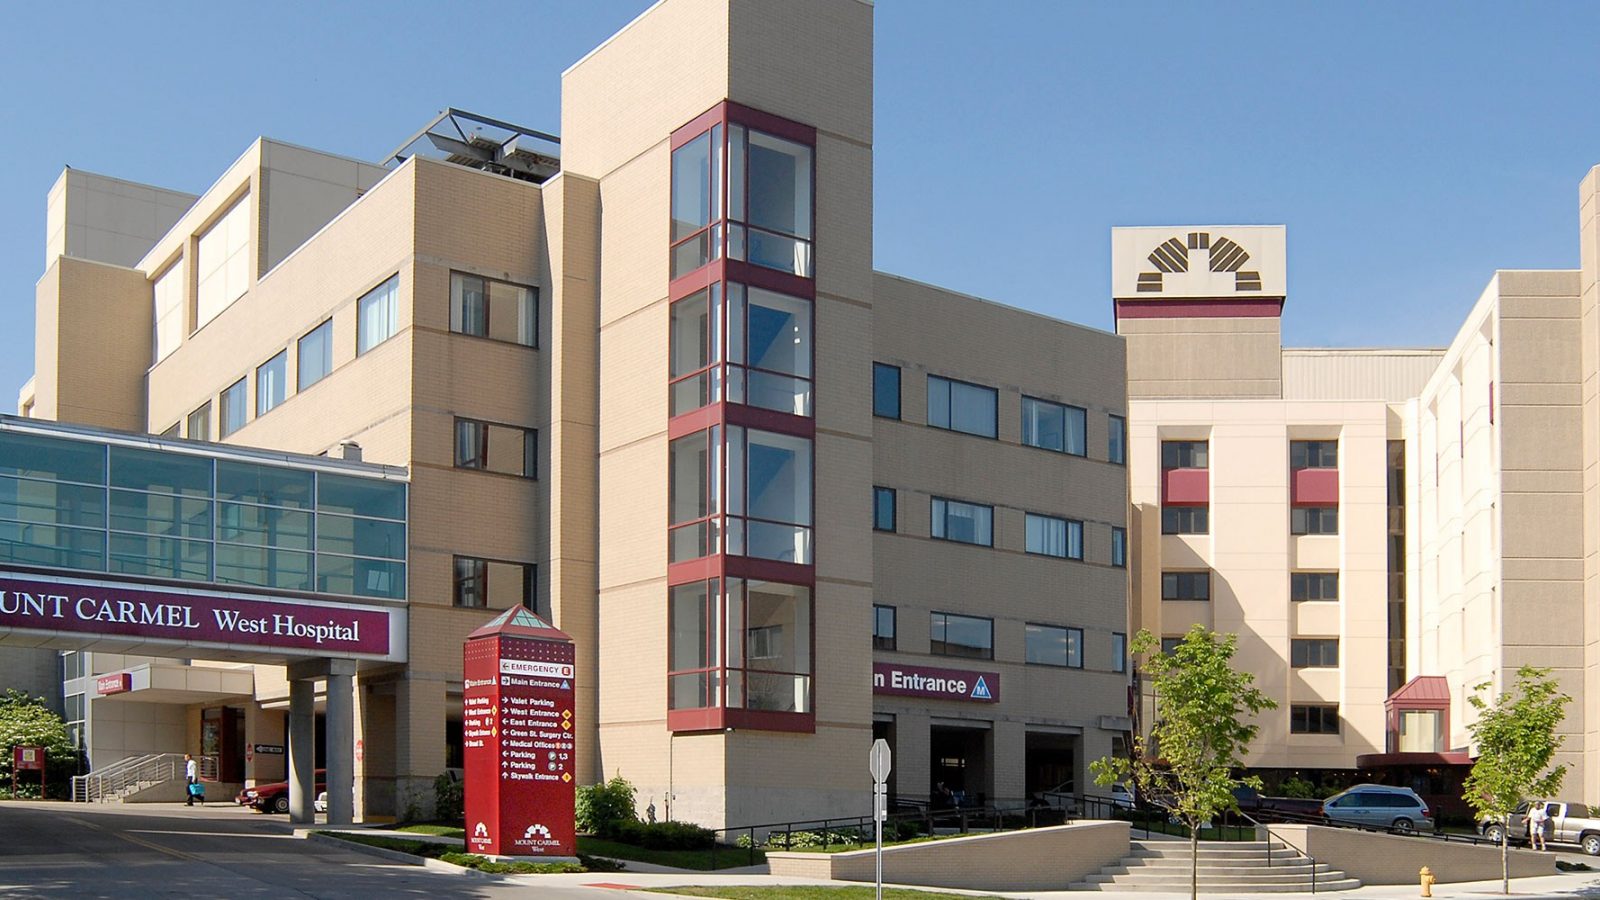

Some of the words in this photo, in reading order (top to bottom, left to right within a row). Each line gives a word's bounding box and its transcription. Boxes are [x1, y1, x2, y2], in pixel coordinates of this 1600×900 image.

[75, 597, 199, 628] CARMEL
[212, 609, 268, 634] West
[272, 614, 360, 643] Hospital
[511, 663, 559, 674] EMERGENCY
[511, 677, 528, 686] Main
[529, 679, 561, 689] Entrance
[891, 670, 967, 694] Entrance
[976, 685, 986, 696] M
[510, 697, 528, 705] Valet
[529, 698, 555, 708] Parking
[510, 707, 528, 716] West
[529, 709, 560, 718] Entrance
[510, 718, 526, 727] East
[527, 719, 558, 728] Entrance
[510, 729, 528, 737] Green
[539, 730, 561, 740] Surgery
[510, 739, 533, 748] Medical
[533, 740, 556, 750] Offices
[510, 750, 536, 760] Parking
[510, 760, 536, 771] Parking
[510, 771, 534, 780] Skywalk
[534, 772, 559, 781] Entrance
[537, 839, 560, 847] CARMEL
